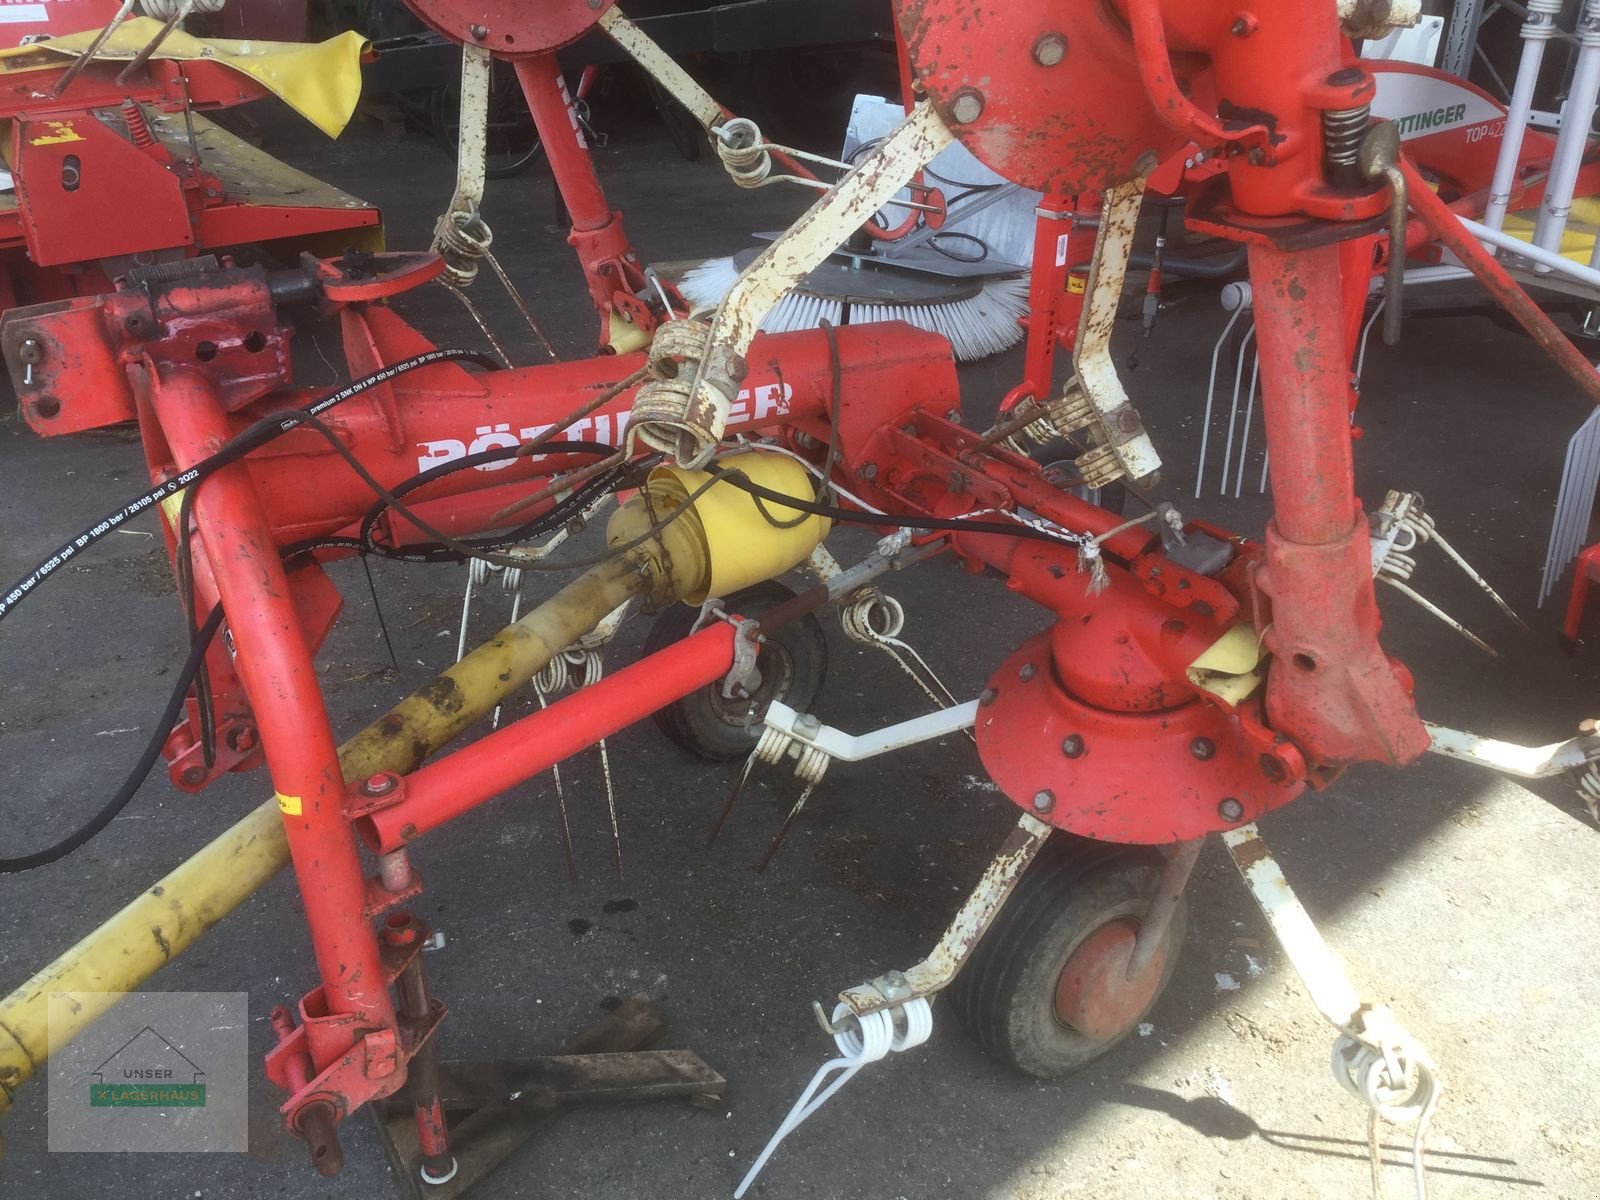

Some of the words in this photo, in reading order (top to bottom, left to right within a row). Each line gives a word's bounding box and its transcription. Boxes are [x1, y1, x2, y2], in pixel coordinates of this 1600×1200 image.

[1392, 104, 1466, 134] TTINGER
[1466, 125, 1488, 143] TOP
[310, 397, 336, 415] premium
[353, 383, 363, 392] DN
[366, 376, 376, 386] WP
[386, 369, 396, 377] bar
[416, 383, 792, 472] PÖTTIER
[6, 588, 23, 605] 450
[20, 577, 36, 590] bar
[35, 571, 41, 579] /
[39, 556, 61, 575] 6525
[60, 546, 74, 560] psi
[75, 535, 88, 547] BP
[90, 522, 110, 537] 1800
[108, 513, 124, 526] bar
[124, 508, 129, 516] /
[128, 496, 152, 513] 26105
[152, 488, 166, 501] psi
